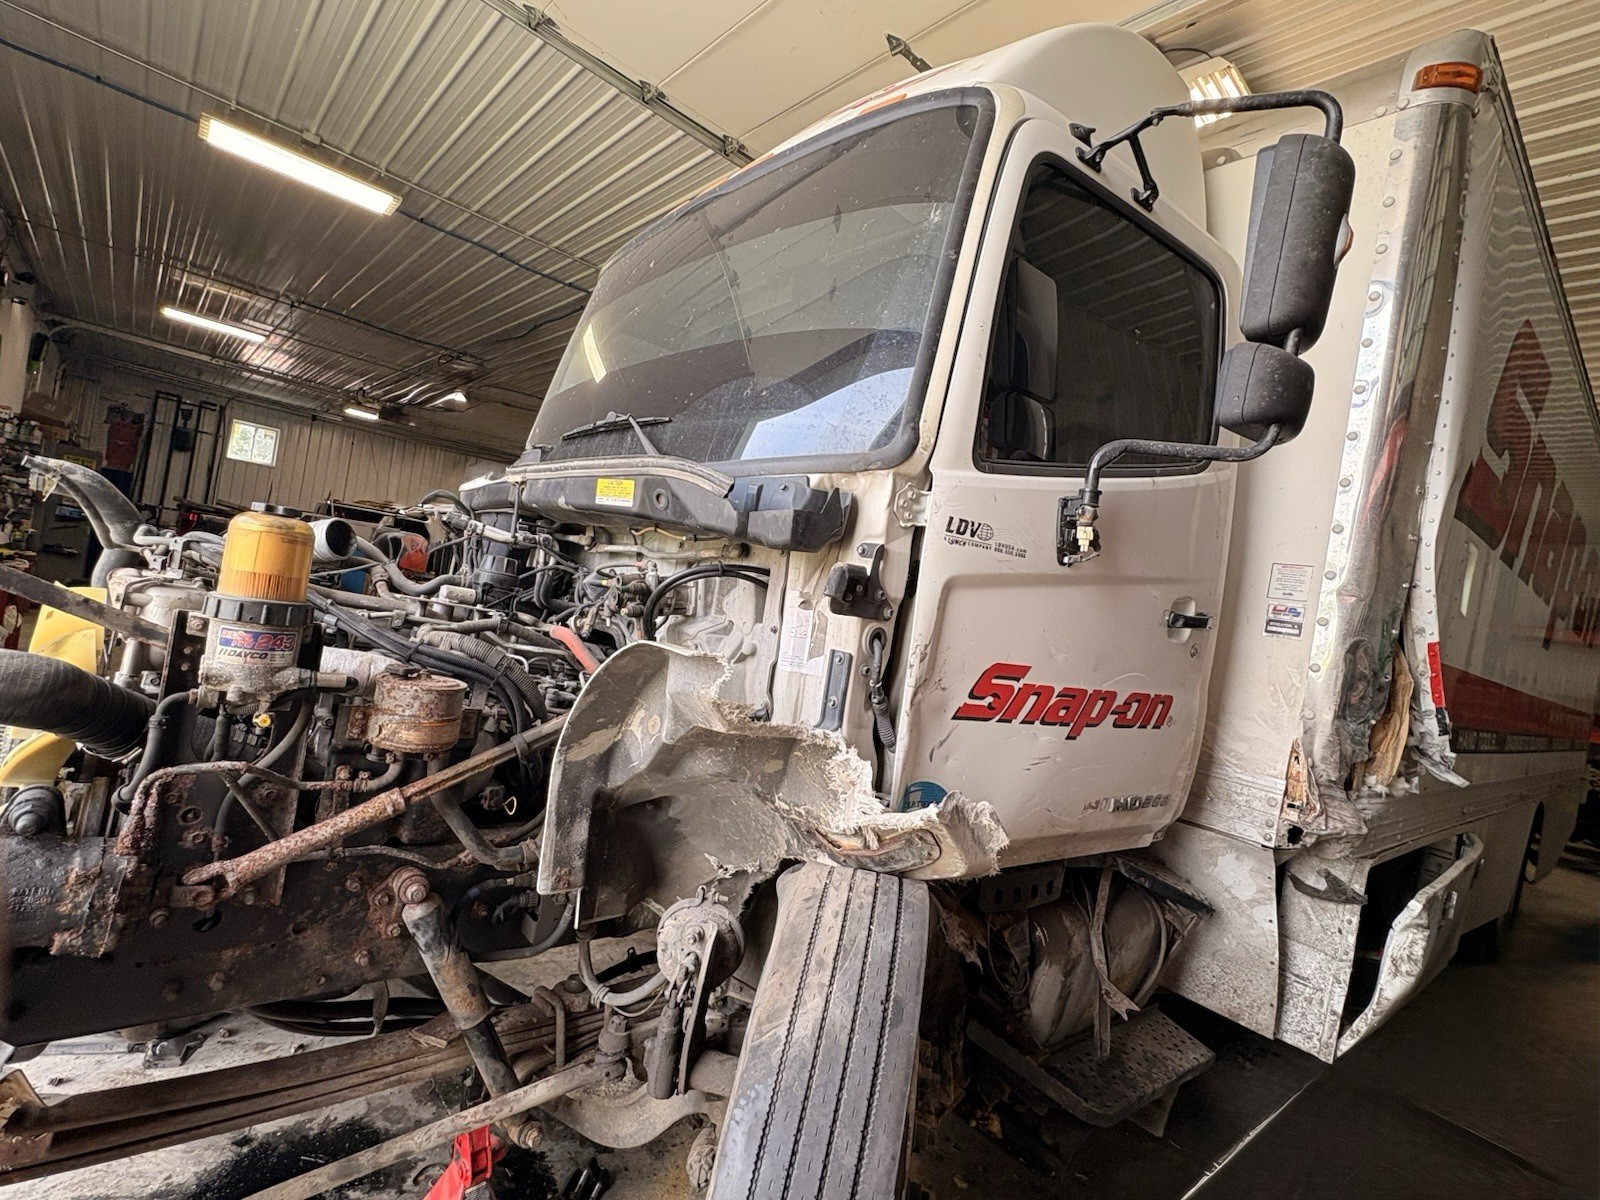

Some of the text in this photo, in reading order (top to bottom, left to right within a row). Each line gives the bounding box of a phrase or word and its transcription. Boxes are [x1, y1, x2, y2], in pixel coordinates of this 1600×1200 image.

[945, 516, 980, 538] LDV
[968, 542, 992, 551] COMPANY
[254, 634, 295, 650] 243
[227, 649, 269, 659] DAVCO
[951, 662, 1173, 740] Snap-on
